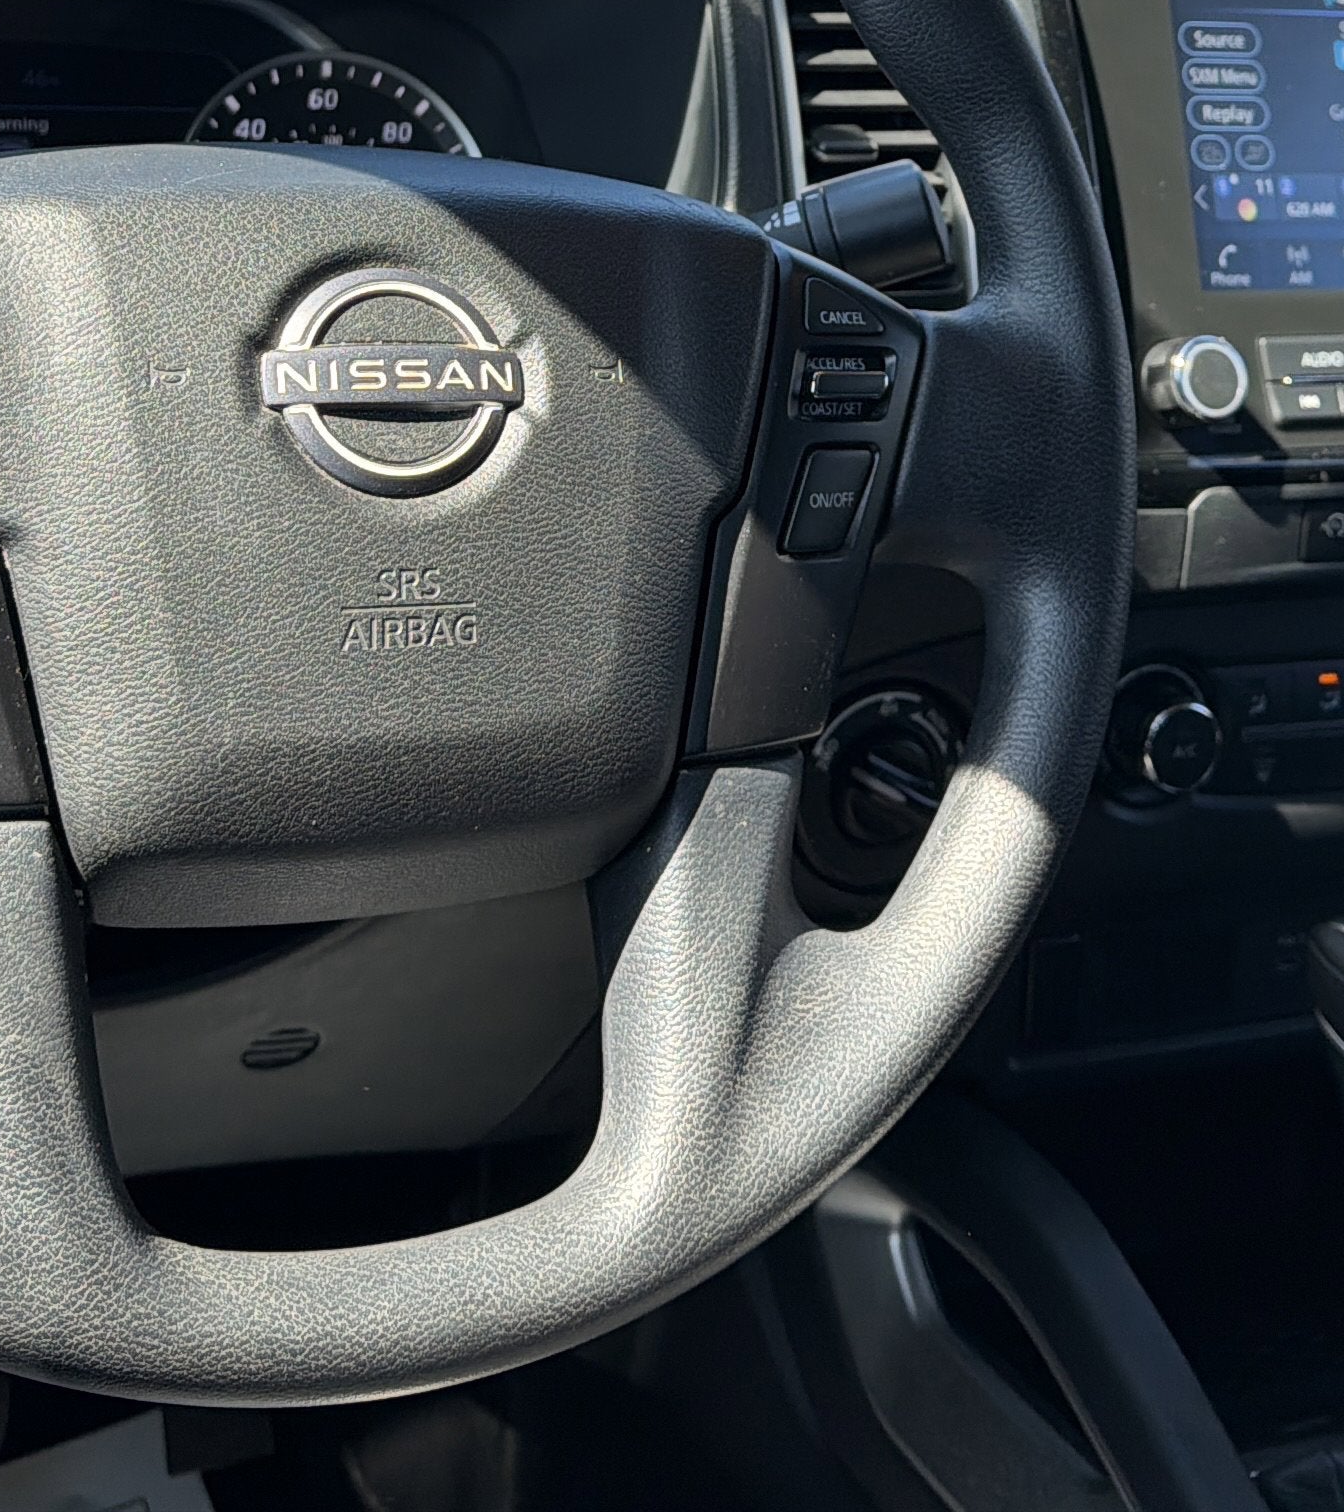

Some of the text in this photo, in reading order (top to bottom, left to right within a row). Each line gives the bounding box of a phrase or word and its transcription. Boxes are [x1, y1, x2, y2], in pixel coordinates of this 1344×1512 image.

[1193, 31, 1246, 50] Source
[307, 88, 339, 111] 60
[1202, 104, 1256, 125] Replay
[232, 118, 267, 141] 40
[381, 121, 413, 144] 80
[1255, 178, 1275, 197] 11
[819, 310, 867, 326] CANCEL
[276, 357, 514, 394] NISSAN
[801, 401, 864, 417] COAST/SET
[809, 491, 855, 509] ON/OFF
[376, 568, 443, 602] SRS
[341, 614, 479, 653] AIRBAG
